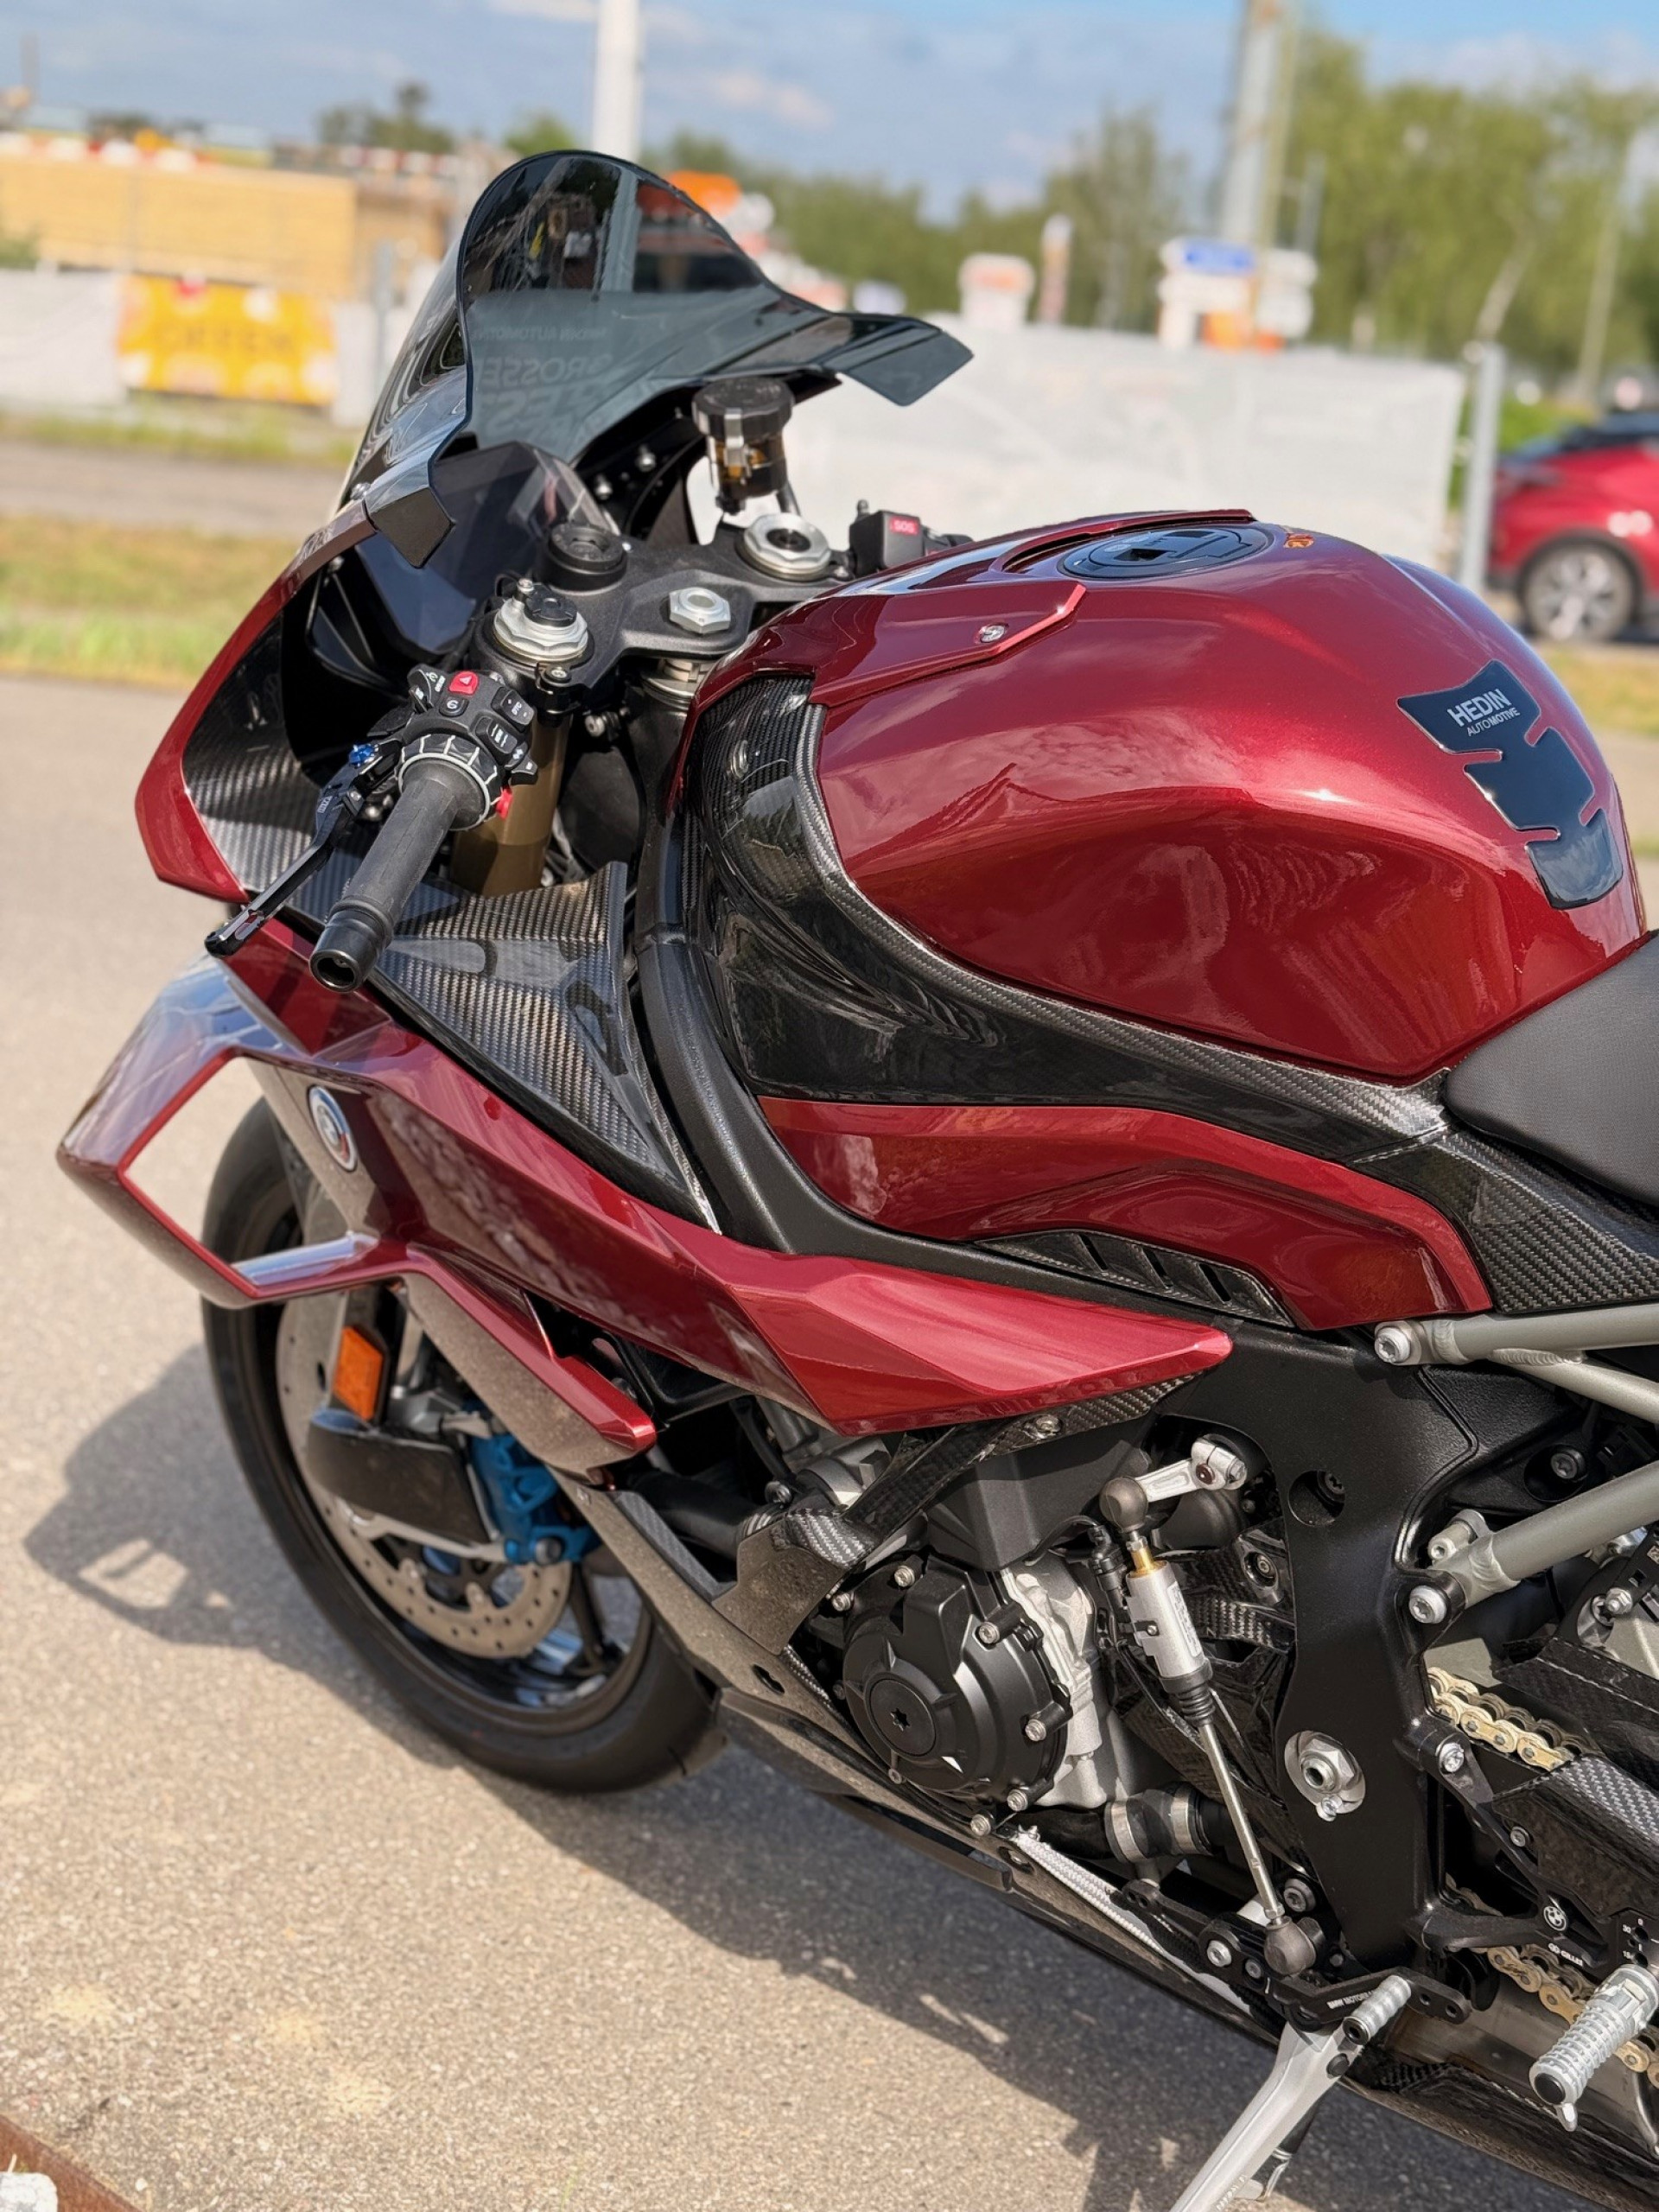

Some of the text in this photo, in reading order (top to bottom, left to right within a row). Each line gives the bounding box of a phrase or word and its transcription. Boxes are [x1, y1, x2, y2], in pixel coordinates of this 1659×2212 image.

[893, 518, 916, 533] SOS
[1447, 689, 1512, 727] HEDIN
[1467, 707, 1521, 736] AUTOMOTIVE
